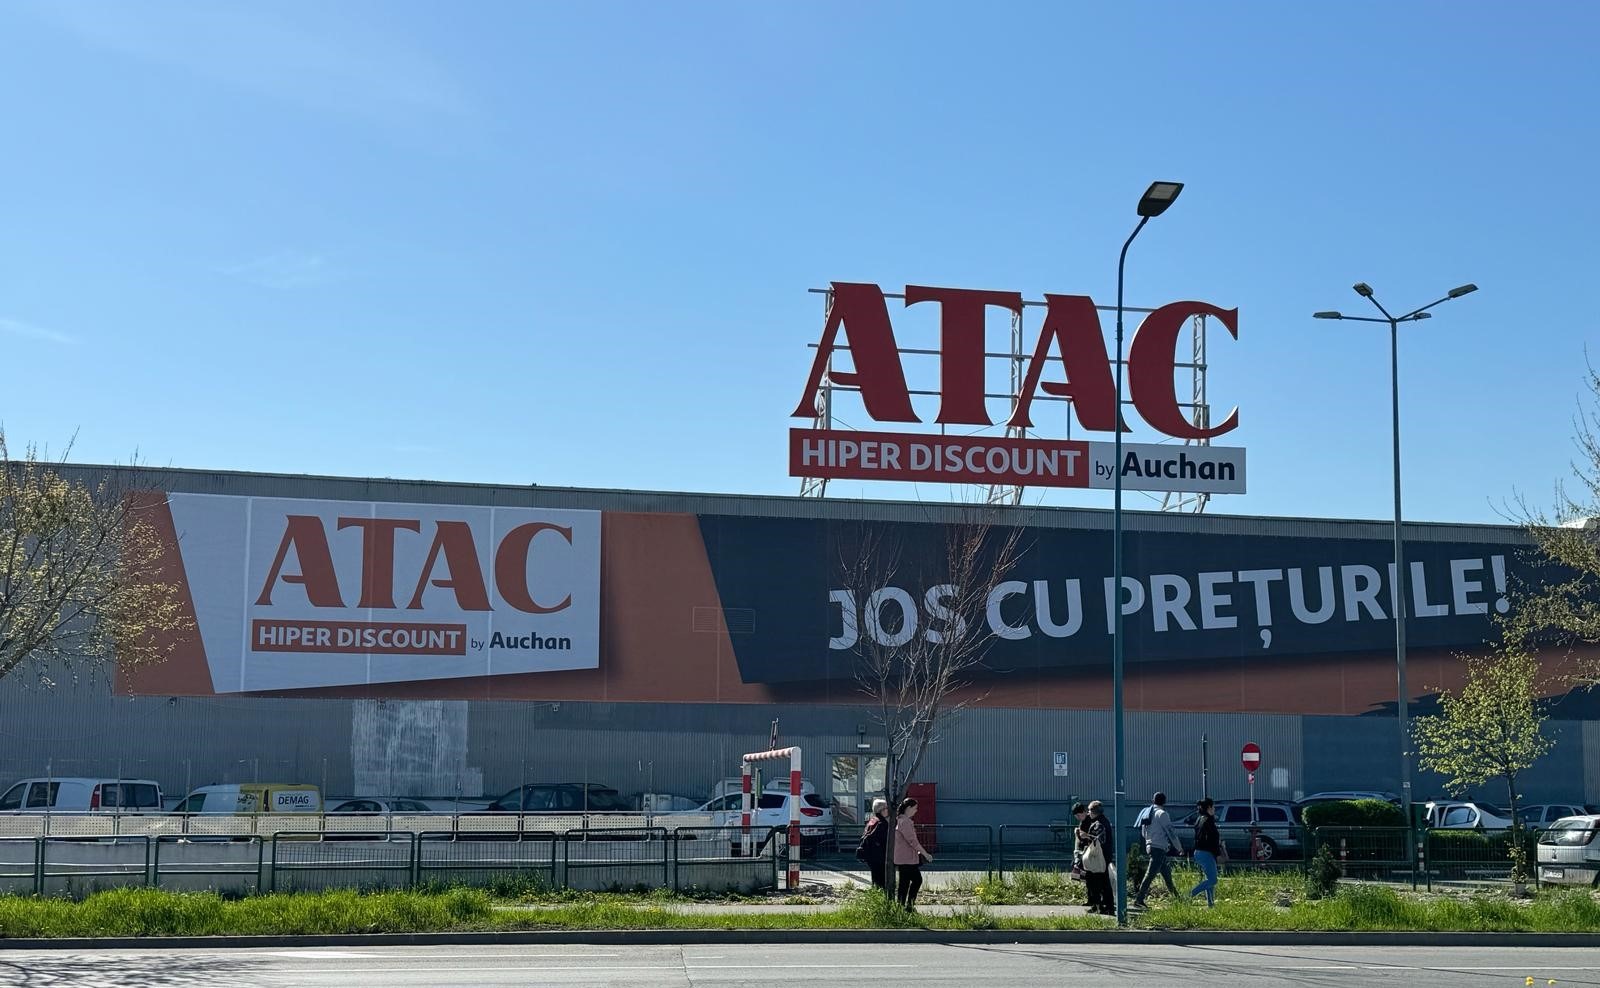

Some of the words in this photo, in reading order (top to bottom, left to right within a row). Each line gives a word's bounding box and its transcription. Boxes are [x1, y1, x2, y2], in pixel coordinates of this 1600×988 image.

[790, 282, 1239, 439] ATAC
[802, 439, 902, 470] HIPER
[910, 443, 1082, 477] DISCOUNT
[1095, 460, 1115, 481] by
[1121, 451, 1236, 481] Auchan
[254, 515, 573, 614] ATAC
[259, 626, 331, 647] HIPER
[337, 628, 461, 649] DISCOUNT
[471, 637, 485, 652] by
[489, 631, 571, 650] Auchan
[828, 583, 967, 650] JOS
[986, 578, 1083, 640] CU
[278, 796, 309, 805] DEMAG
